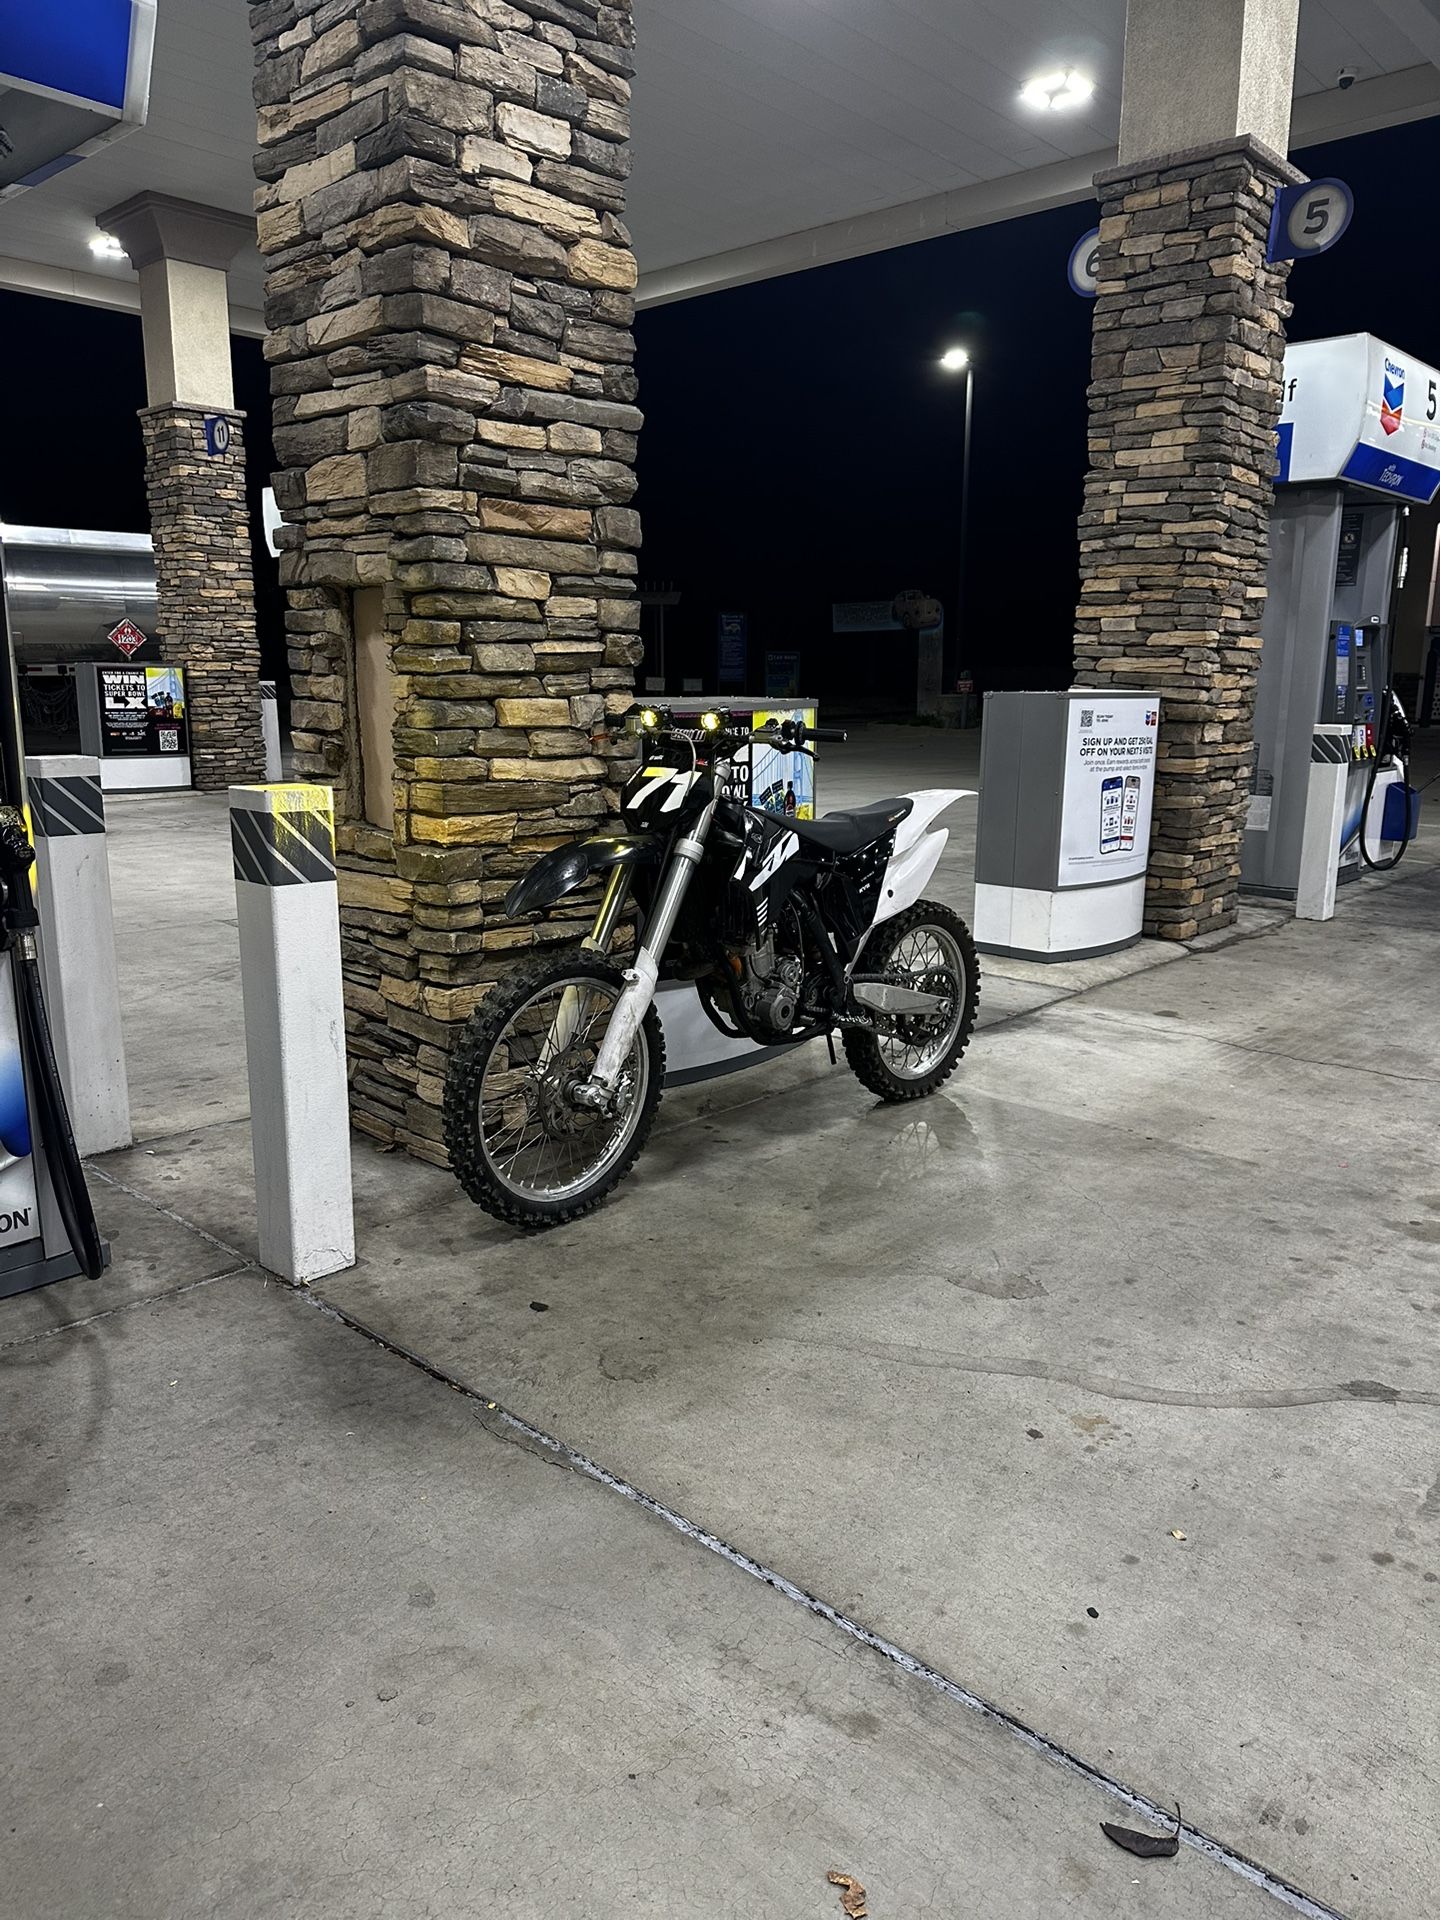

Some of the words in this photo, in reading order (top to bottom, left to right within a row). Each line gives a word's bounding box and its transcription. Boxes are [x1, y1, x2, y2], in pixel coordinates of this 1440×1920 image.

[1303, 198, 1330, 235] 5
[1384, 357, 1406, 380] Chevron
[1426, 379, 1437, 421] 5
[217, 425, 225, 443] 11
[102, 675, 145, 684] WIN
[105, 697, 147, 709] LX
[740, 726, 750, 736] TO
[1082, 737, 1102, 746] SIGN
[1103, 737, 1113, 746] UP
[1114, 737, 1127, 746] AND
[1127, 736, 1139, 745] GET
[1080, 747, 1096, 757] OFF
[1097, 747, 1108, 757] ON
[1109, 747, 1126, 756] YOUR
[1126, 747, 1139, 755] NEXT
[731, 765, 749, 783] TO
[721, 784, 749, 799] OWL
[0, 1208, 30, 1234] ON
